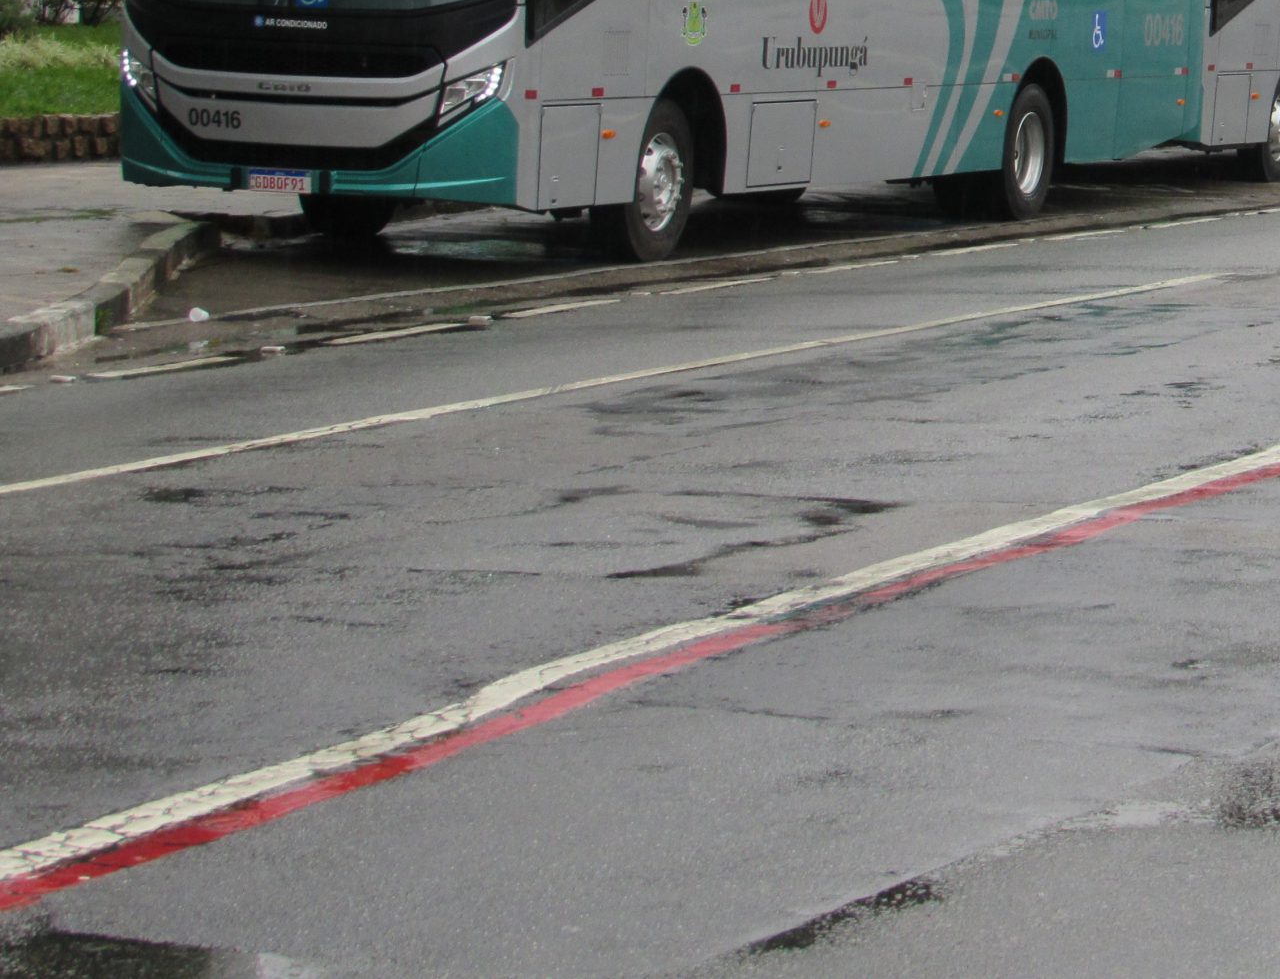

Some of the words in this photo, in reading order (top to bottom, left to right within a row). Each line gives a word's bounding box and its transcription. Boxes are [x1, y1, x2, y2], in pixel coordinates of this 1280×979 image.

[276, 18, 328, 30] CONDICIONADO
[761, 35, 869, 77] Urubupungá
[188, 107, 242, 130] 00416
